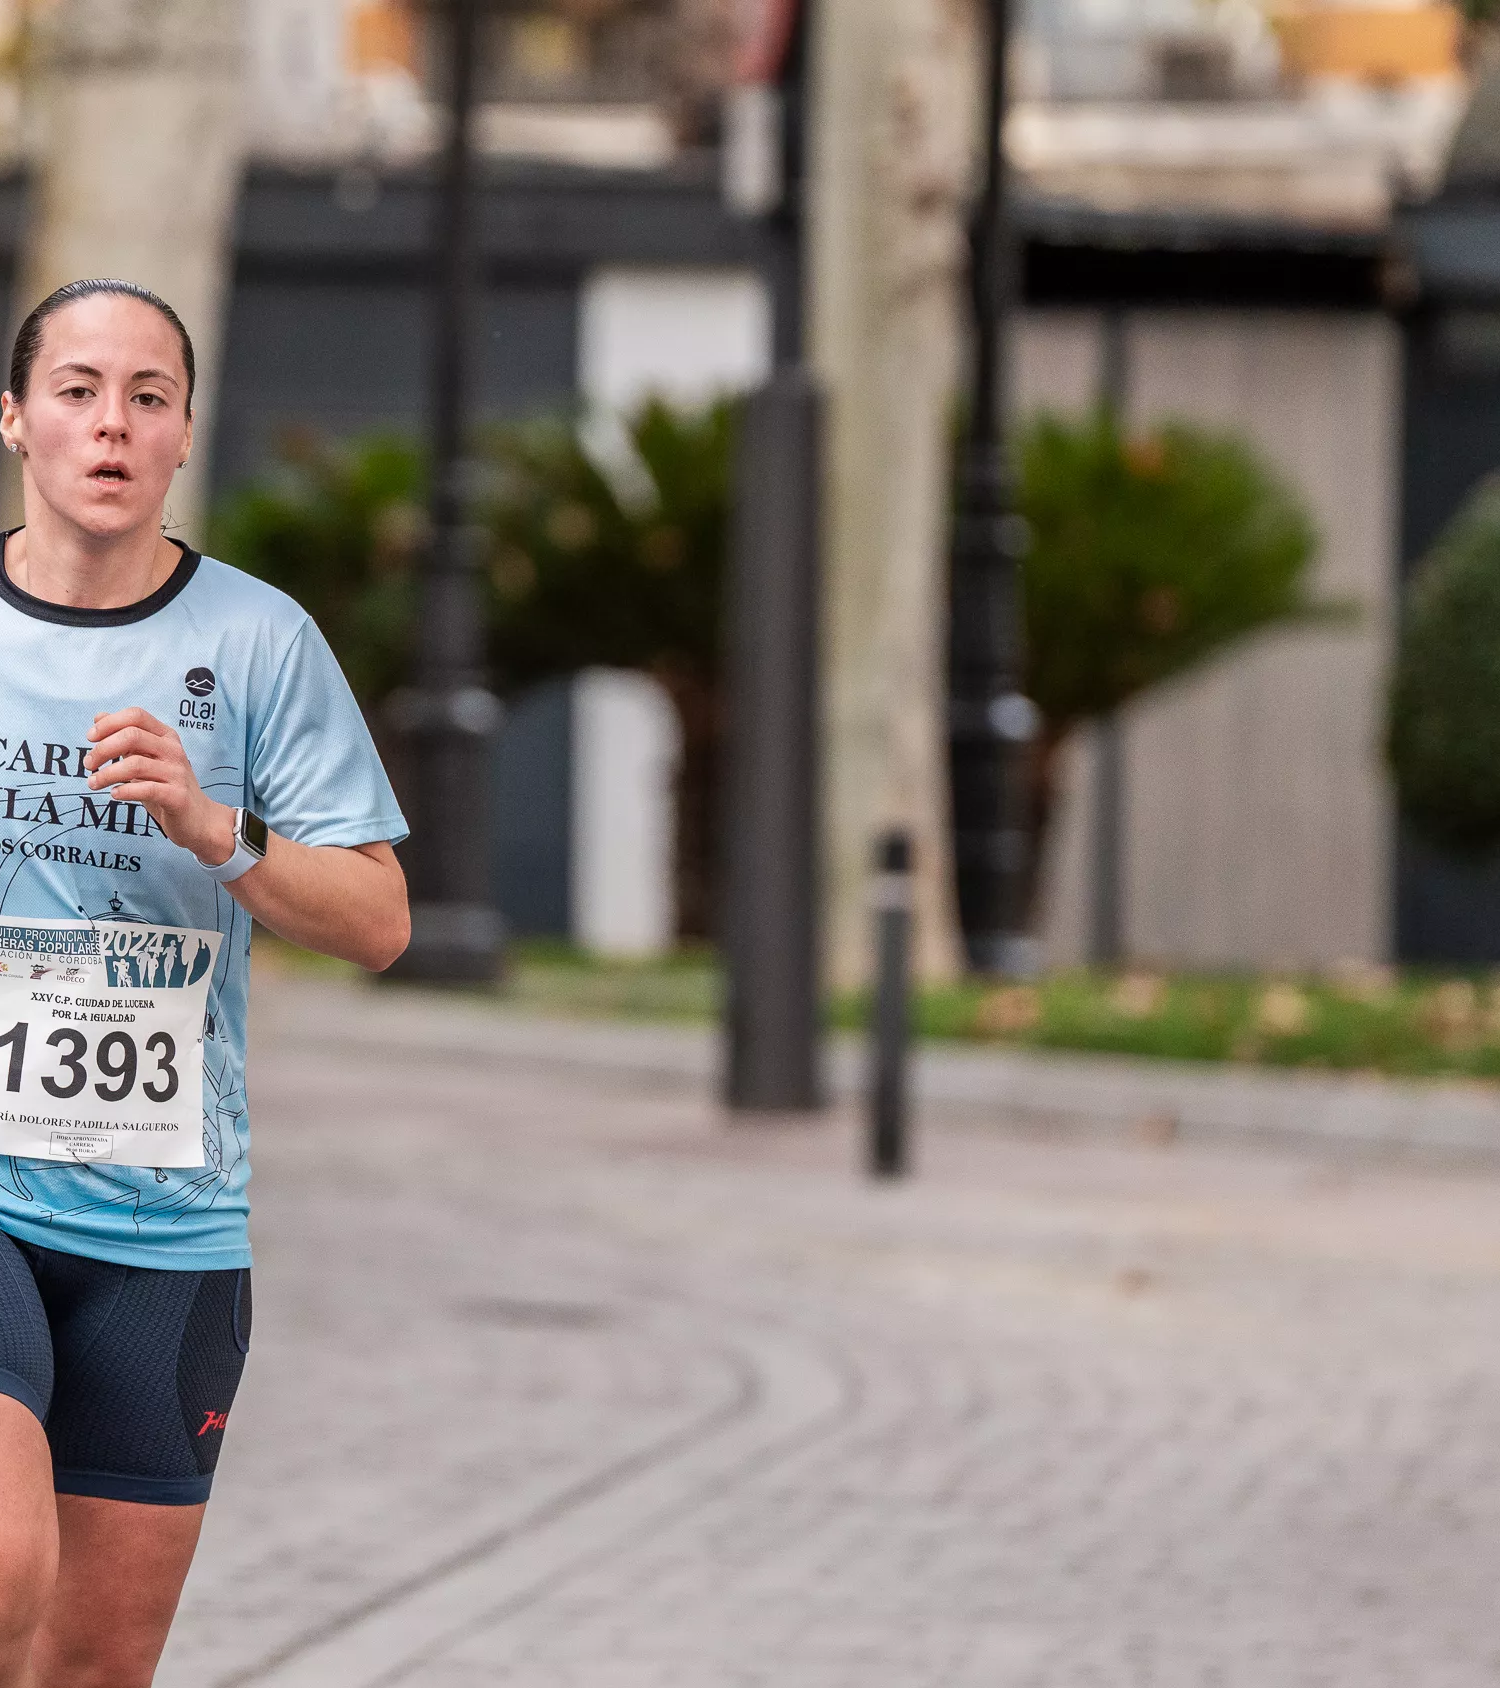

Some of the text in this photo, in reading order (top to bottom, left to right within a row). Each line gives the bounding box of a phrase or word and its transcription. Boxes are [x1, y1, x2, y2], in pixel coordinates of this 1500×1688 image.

[179, 719, 215, 731] RIVERS
[19, 841, 141, 872] CORRALES
[25, 930, 88, 942] PROVINCIAL
[89, 931, 100, 943] DE
[101, 930, 165, 957] 2024
[38, 940, 101, 955] POPULARES
[40, 954, 52, 962] DE
[59, 954, 103, 965] CÓRDOBA
[56, 975, 85, 983] IMDECO
[31, 992, 155, 1009] XXV C.P. CIUDAD DE LUCENA
[52, 1009, 136, 1023] POR LA IGUALDAD
[19, 1114, 72, 1128] DOLORES
[74, 1119, 120, 1130] PADILLA
[121, 1122, 179, 1132] SALGUEROS
